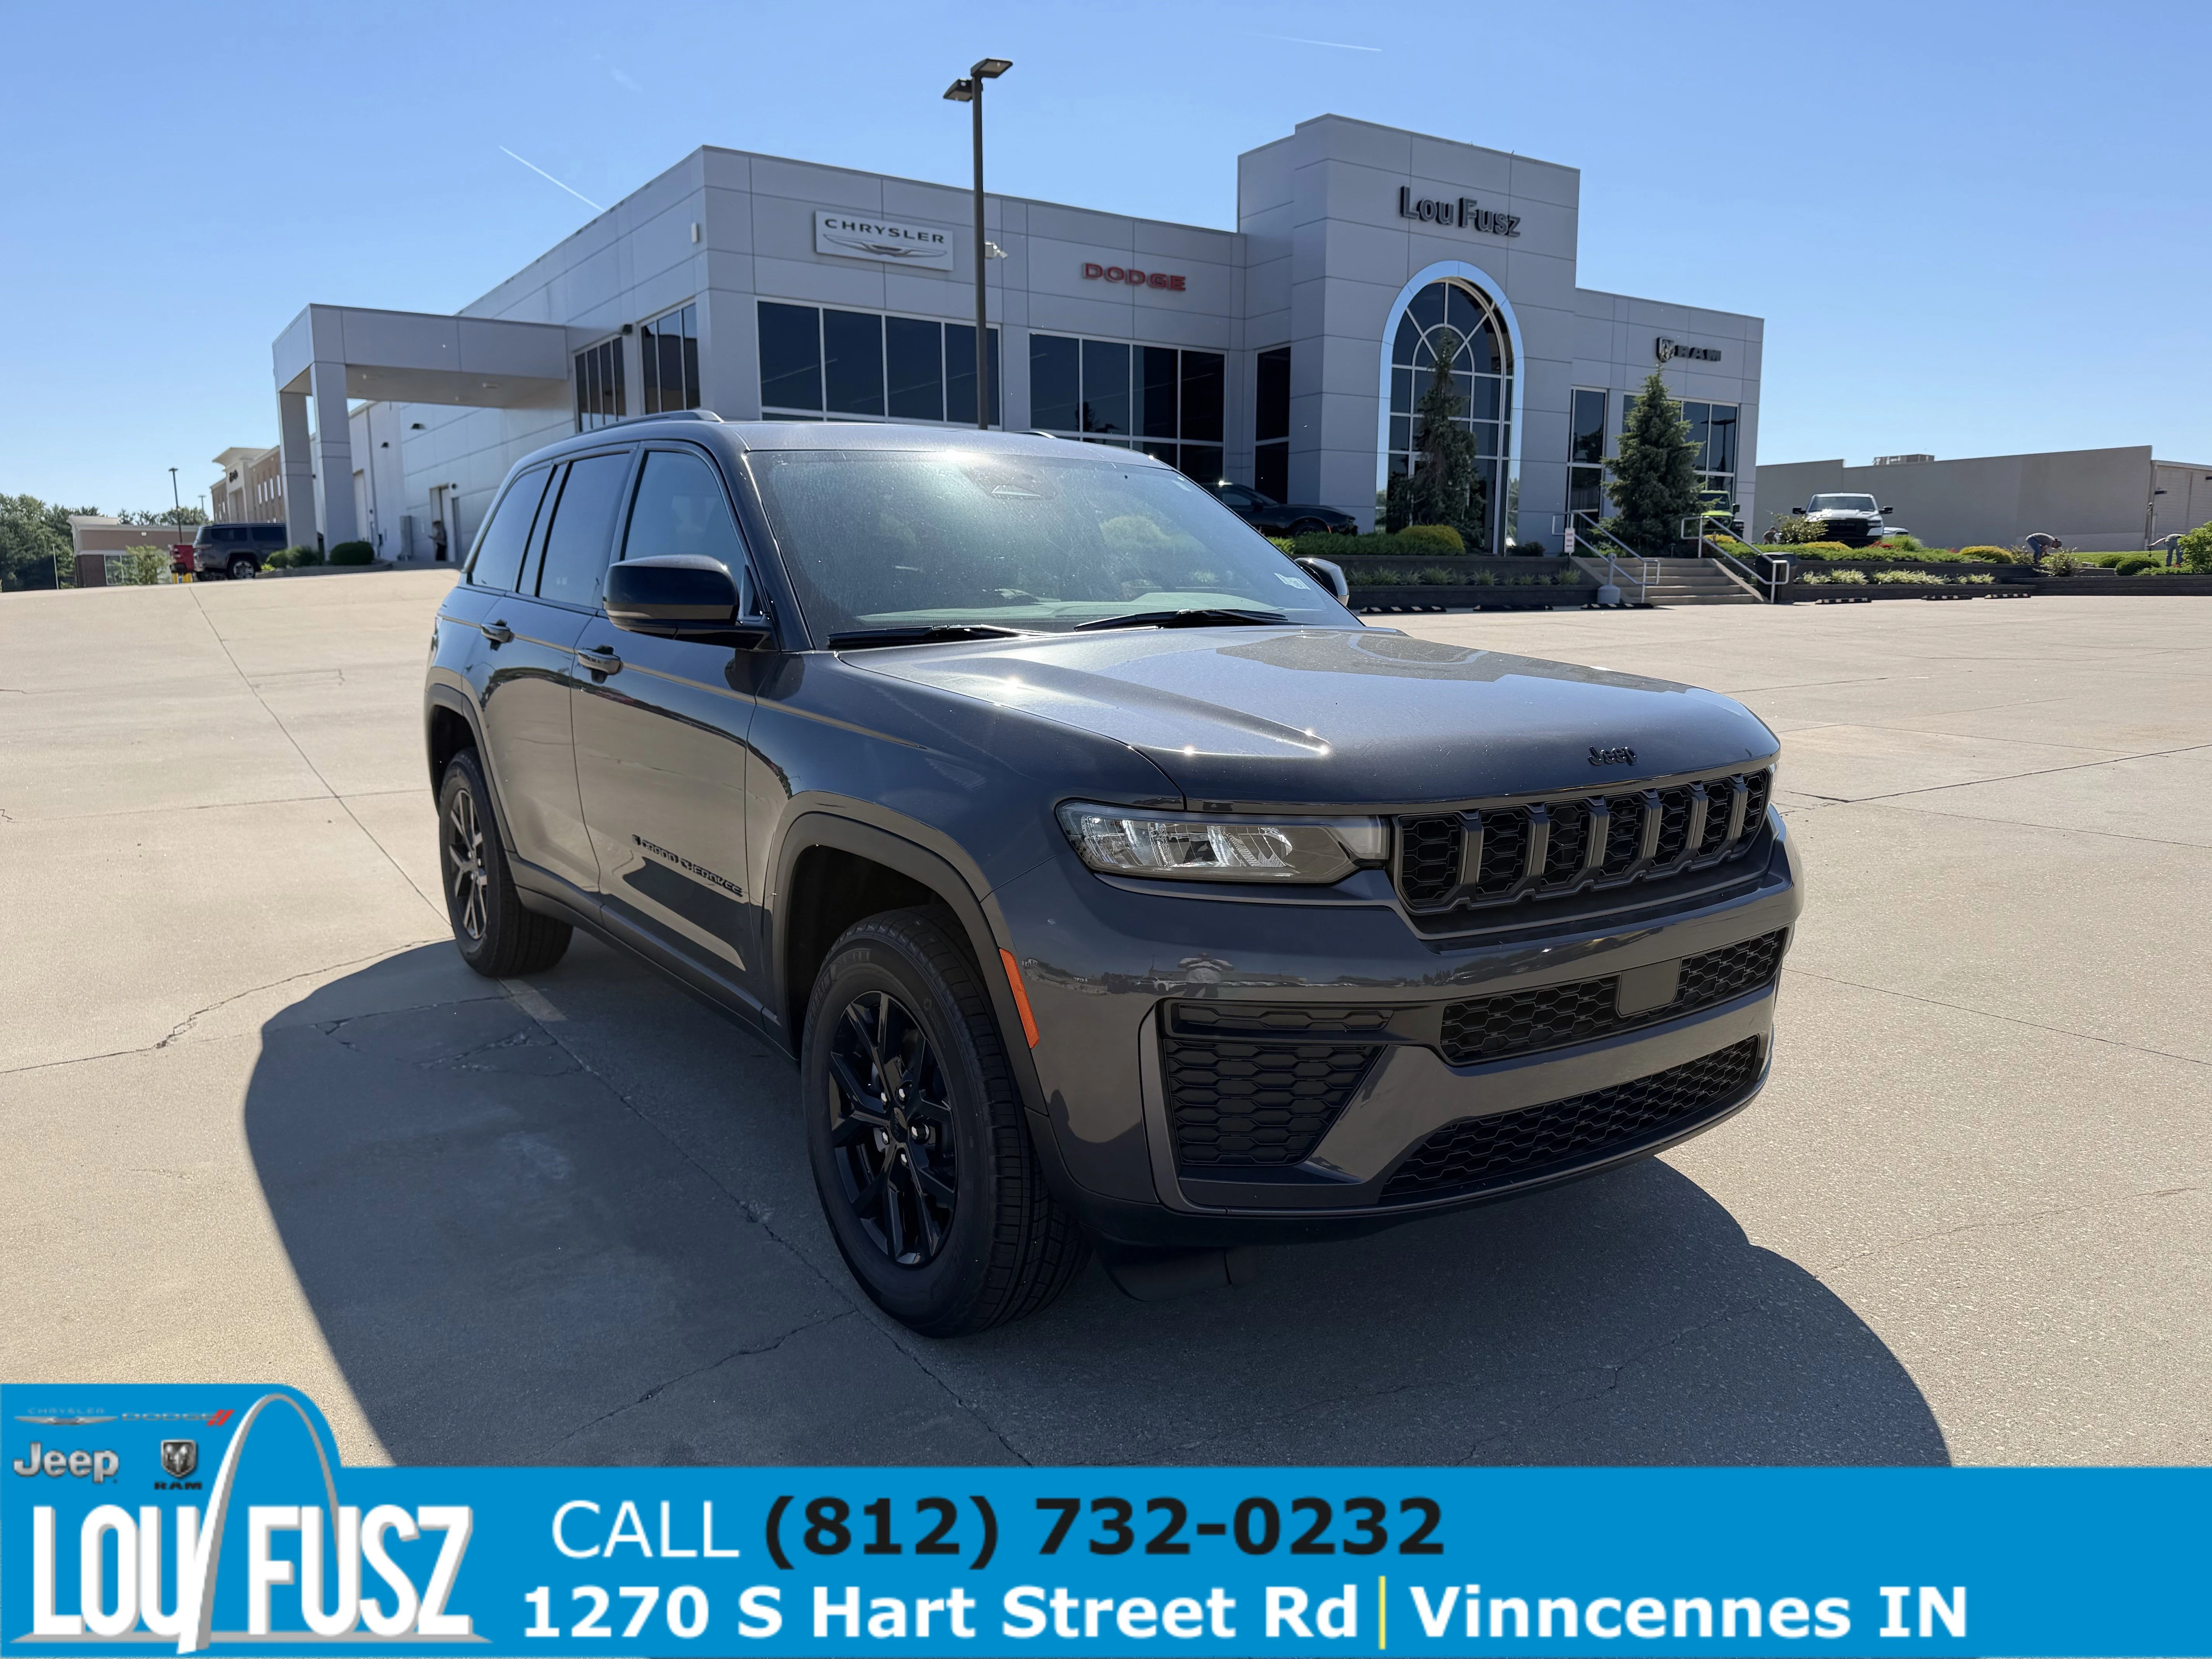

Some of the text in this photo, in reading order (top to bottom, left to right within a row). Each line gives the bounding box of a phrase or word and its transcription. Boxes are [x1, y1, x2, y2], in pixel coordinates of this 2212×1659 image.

[1400, 185, 1521, 237] Lou Fusz
[823, 218, 946, 245] CHRYSLER
[1084, 263, 1186, 292] DODGE
[1675, 345, 1721, 361] RAM
[1588, 746, 1638, 766] Jeep
